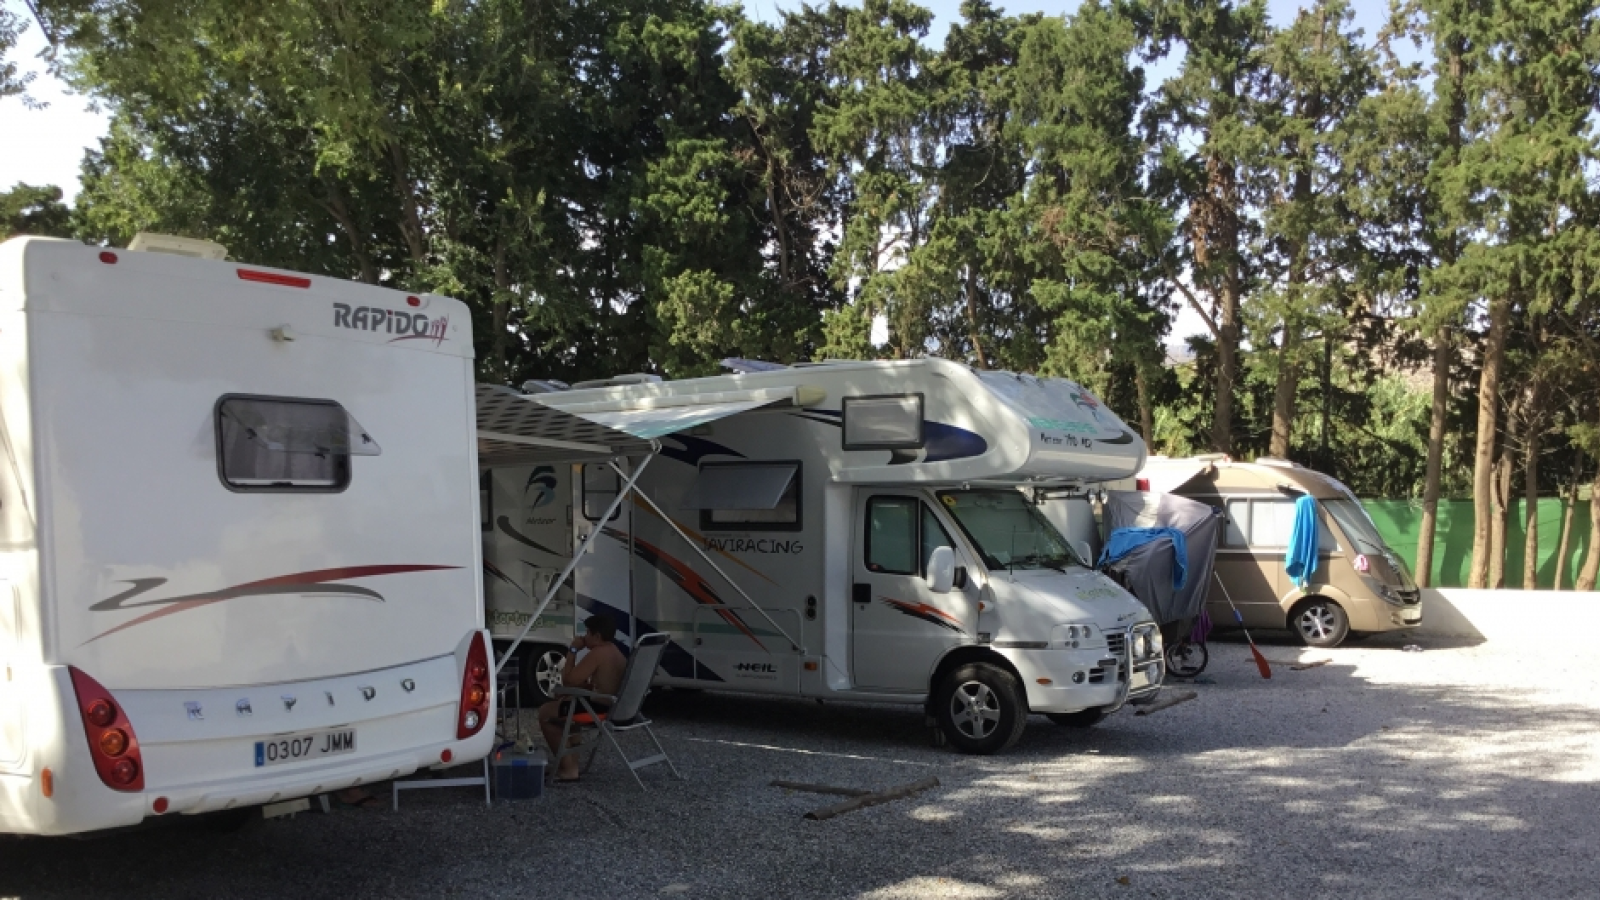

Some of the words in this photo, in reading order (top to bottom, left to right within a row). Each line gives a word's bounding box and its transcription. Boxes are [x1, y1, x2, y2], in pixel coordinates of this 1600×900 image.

[735, 662, 777, 673] NEIL
[266, 735, 314, 762] 0307
[320, 730, 354, 753] JMM
